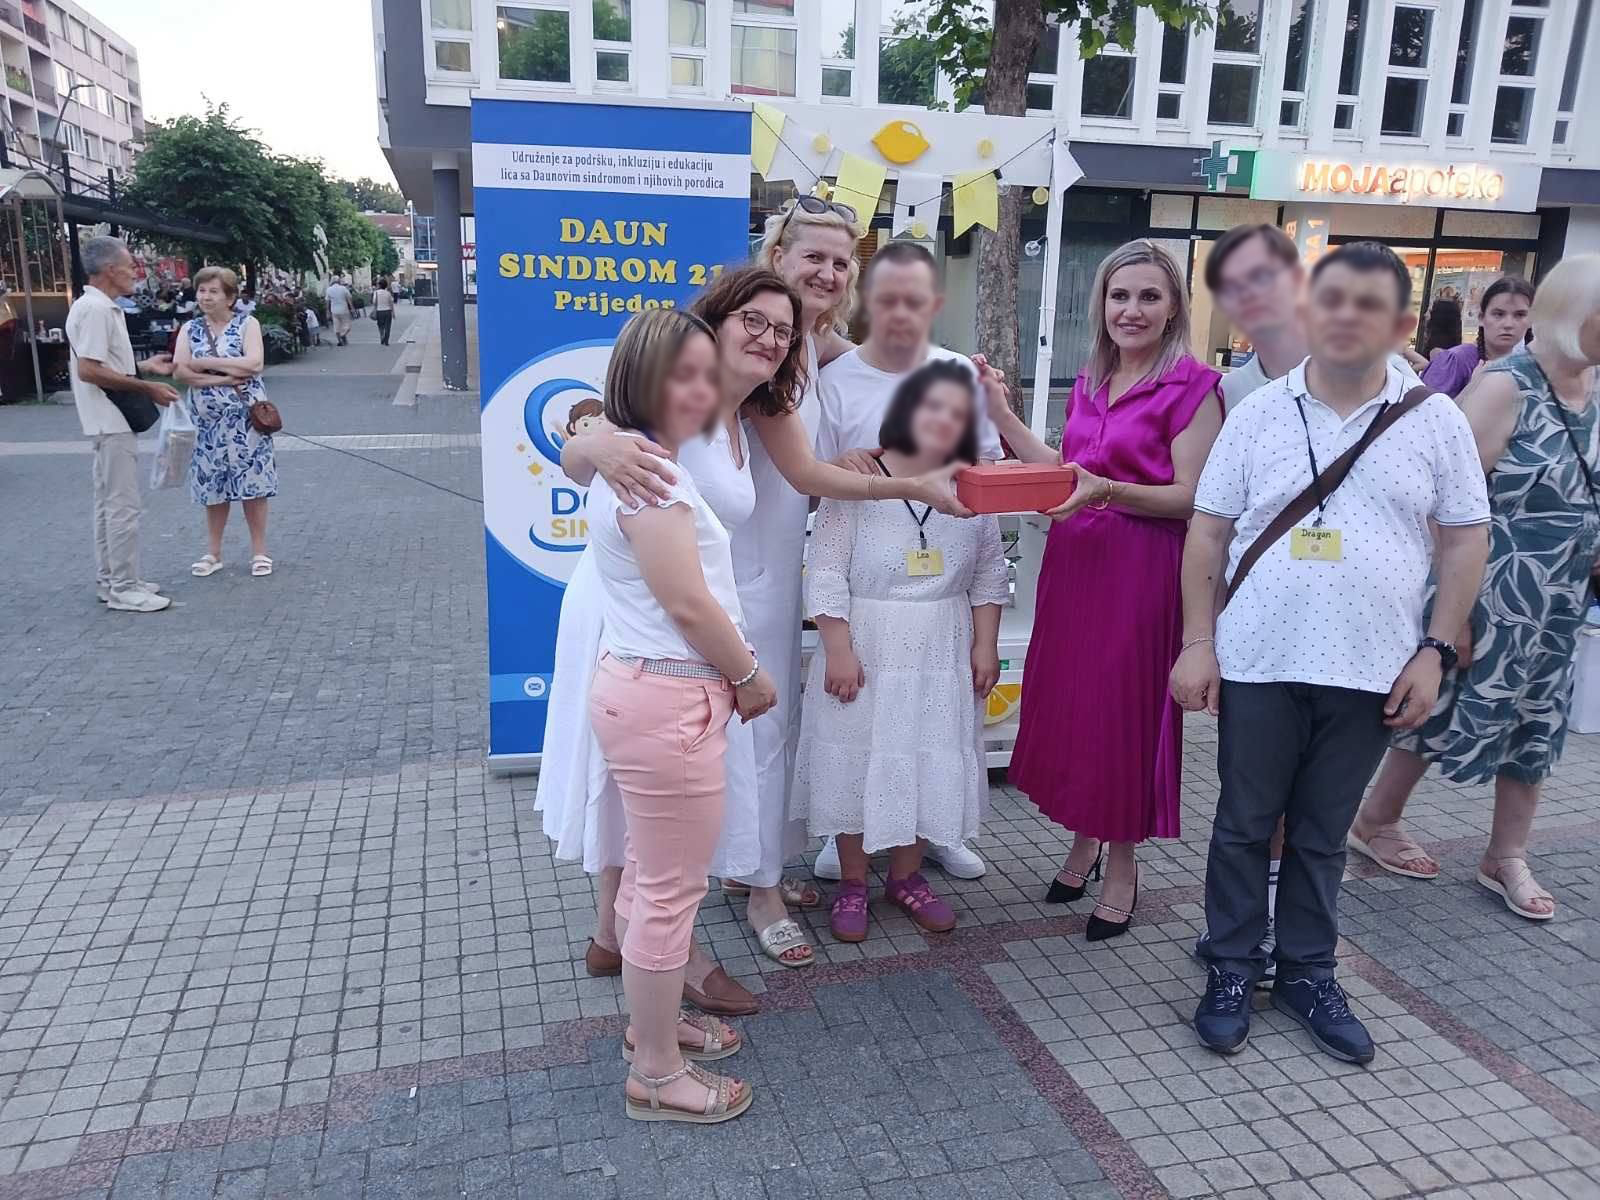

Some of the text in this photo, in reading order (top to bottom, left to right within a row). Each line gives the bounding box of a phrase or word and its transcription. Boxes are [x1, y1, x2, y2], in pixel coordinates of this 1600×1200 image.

[512, 151, 560, 166] Udruženje
[562, 155, 573, 165] za
[618, 155, 660, 170] inkluziju
[668, 157, 713, 173] edukaciju
[501, 167, 518, 180] lica
[520, 171, 531, 180] sa
[533, 169, 581, 183] Daunovim
[583, 171, 636, 185] sindromom
[643, 174, 682, 188] njihovih
[685, 176, 724, 190] porodica
[559, 218, 668, 246] DAUN
[499, 253, 677, 284] SINDROM
[554, 290, 676, 316] Prijedor
[1301, 529, 1332, 541] Dragan
